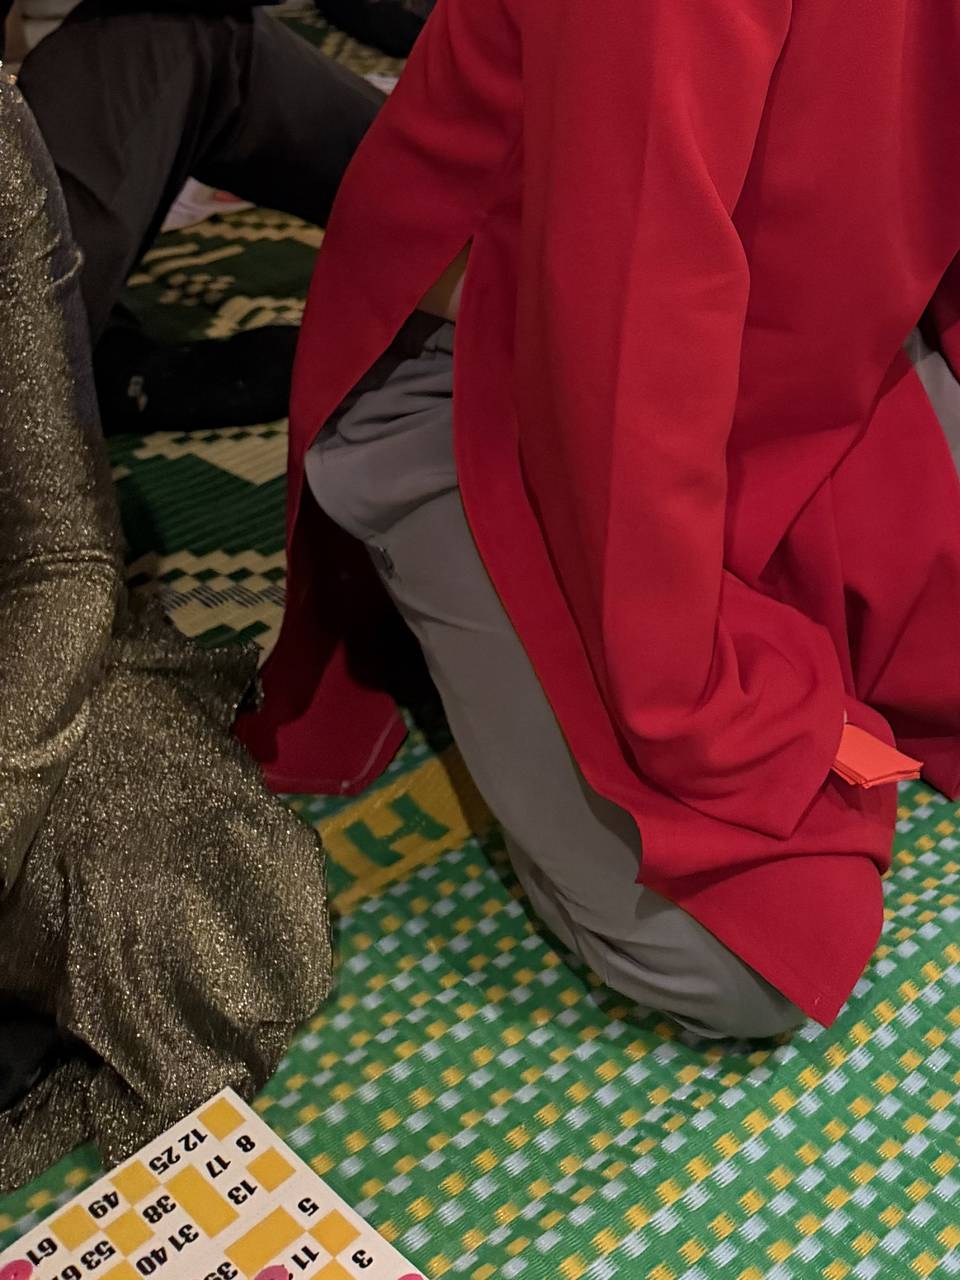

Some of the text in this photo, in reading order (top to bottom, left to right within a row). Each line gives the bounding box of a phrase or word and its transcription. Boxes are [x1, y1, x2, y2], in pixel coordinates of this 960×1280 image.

[26, 1129, 207, 1266] 12 25 49 61
[52, 1135, 255, 1280] 8 17 38 53 6
[298, 1198, 319, 1216] 5
[136, 1180, 257, 1275] 13 31 40
[291, 1246, 319, 1270] 11
[352, 1250, 373, 1268] 3
